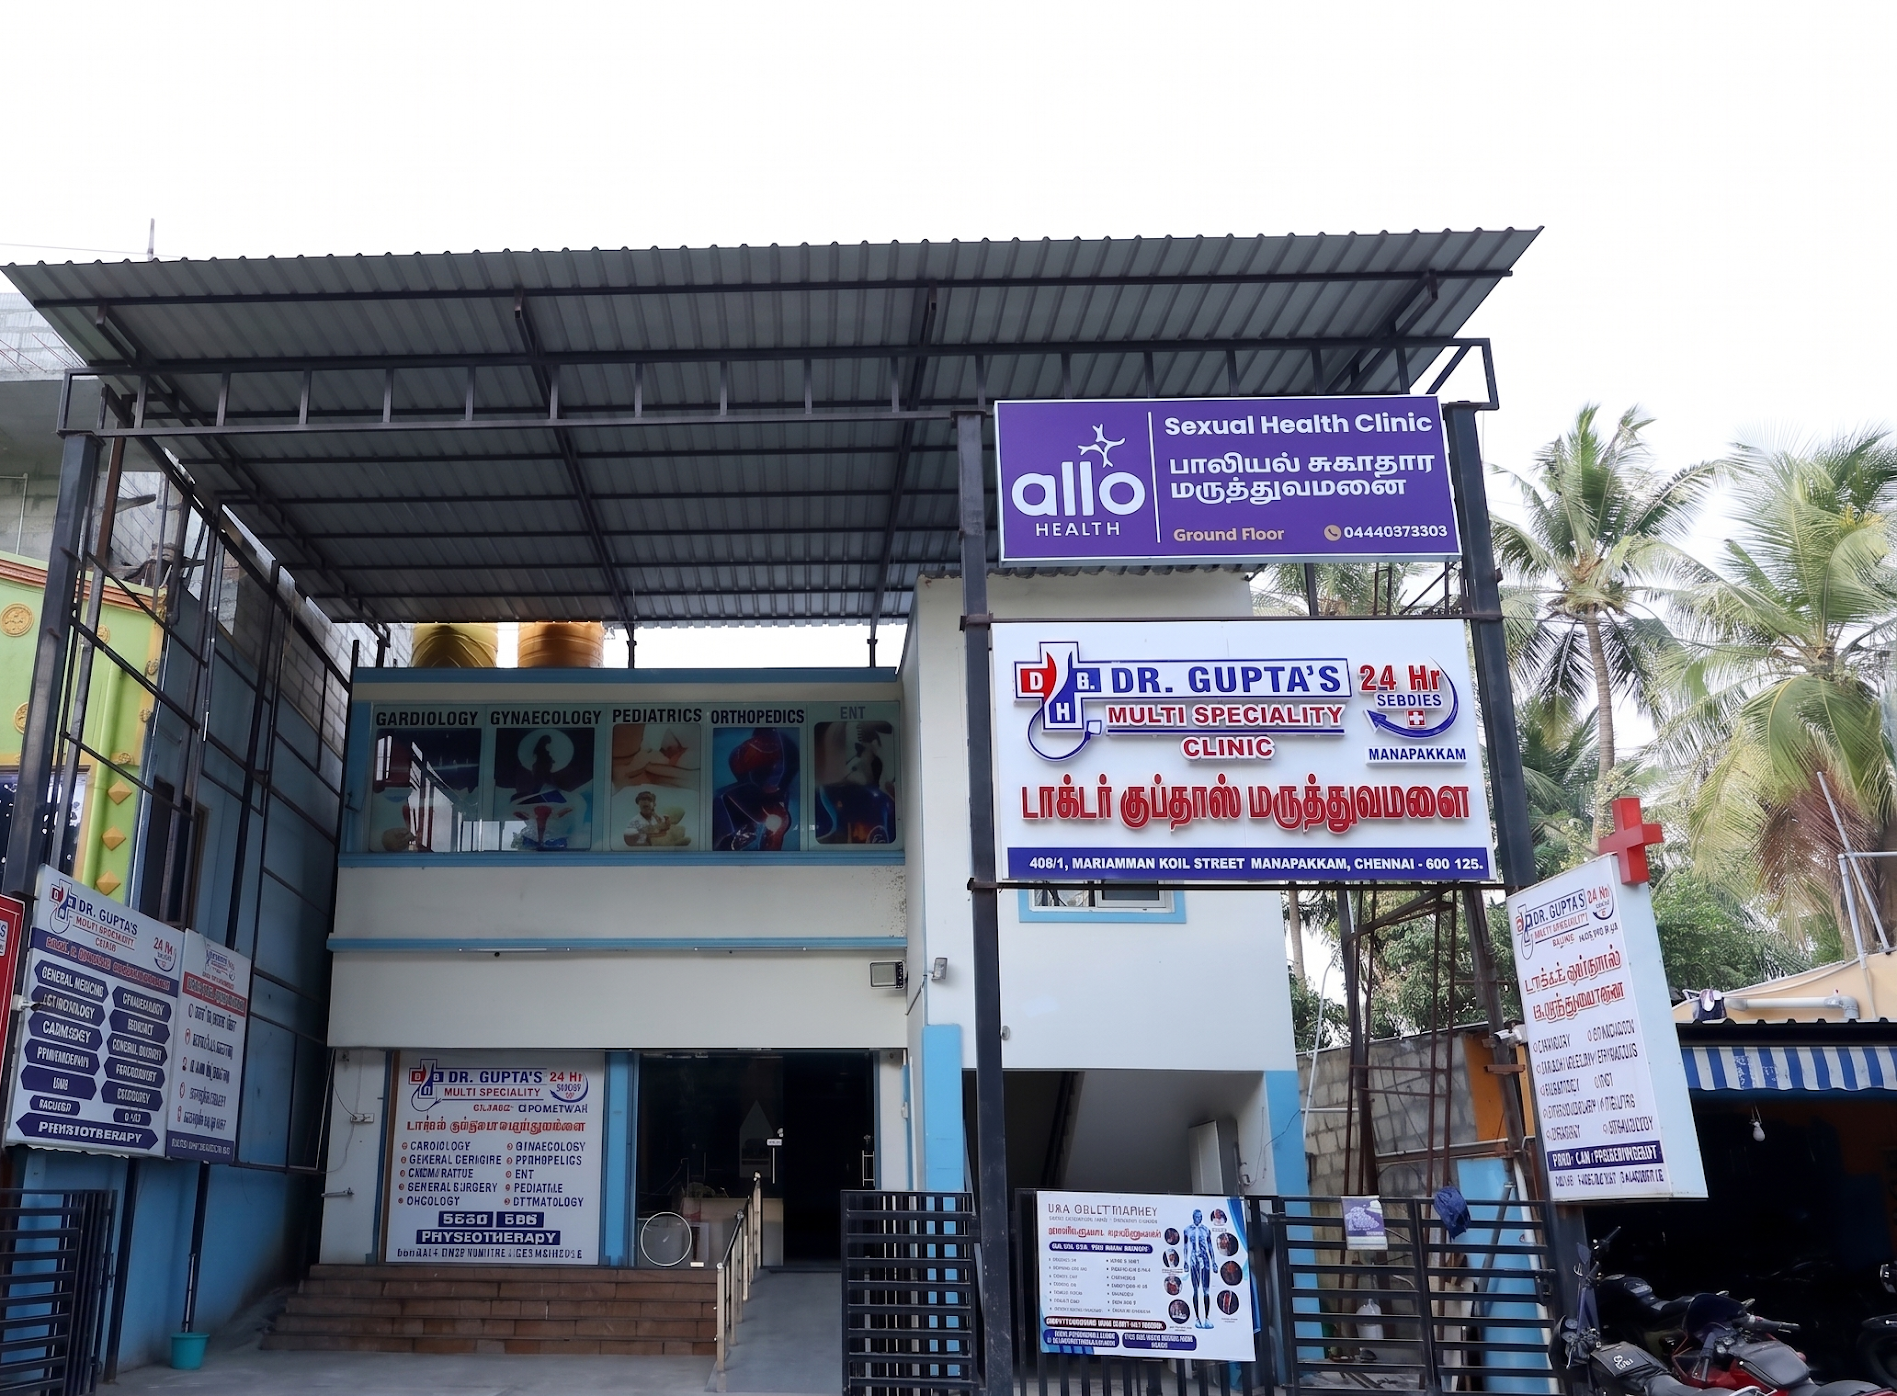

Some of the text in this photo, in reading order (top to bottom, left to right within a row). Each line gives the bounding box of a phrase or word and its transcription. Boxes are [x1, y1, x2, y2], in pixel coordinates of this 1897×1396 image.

[1165, 412, 1433, 435] Sexual Health Clinic
[1170, 452, 1435, 477] பாலியல் சுகாதார
[1011, 461, 1146, 516] allo
[1171, 477, 1406, 505] மருத்துவமனை
[1036, 522, 1120, 537] HEALTH
[1173, 527, 1284, 543] Ground Floor
[1344, 525, 1448, 539] 04440373303
[1029, 671, 1044, 690] D
[1111, 664, 1341, 694] DR. GUPTA'S
[1359, 664, 1440, 692] 24 Hr
[490, 710, 602, 726] GYNAECOLOGY
[612, 708, 702, 723] PEDIATRICS
[711, 709, 805, 724] ORTHOPEDICS
[840, 706, 866, 720] ENT
[1108, 706, 1342, 724] MULTI SPECIALITY
[1183, 738, 1274, 757] CLINIC
[1368, 748, 1467, 761] MANAPAKKAM
[1021, 773, 1113, 820] டாக்டர்
[1120, 773, 1242, 831] குப்தாஸ்
[1072, 858, 1156, 869] MARIAMMAN
[1159, 858, 1190, 869] KOIL
[1194, 858, 1246, 869] STREET
[1251, 858, 1351, 871] MANAPAKKAM,
[1354, 858, 1415, 870] CHENNAI
[1425, 858, 1450, 870] 600
[1455, 858, 1484, 870] 125.
[449, 1071, 543, 1084] DR. GUPTA'S
[550, 1071, 564, 1082] 24
[445, 1087, 541, 1097] MULTI SPECIALITY
[515, 1169, 534, 1179] ENT
